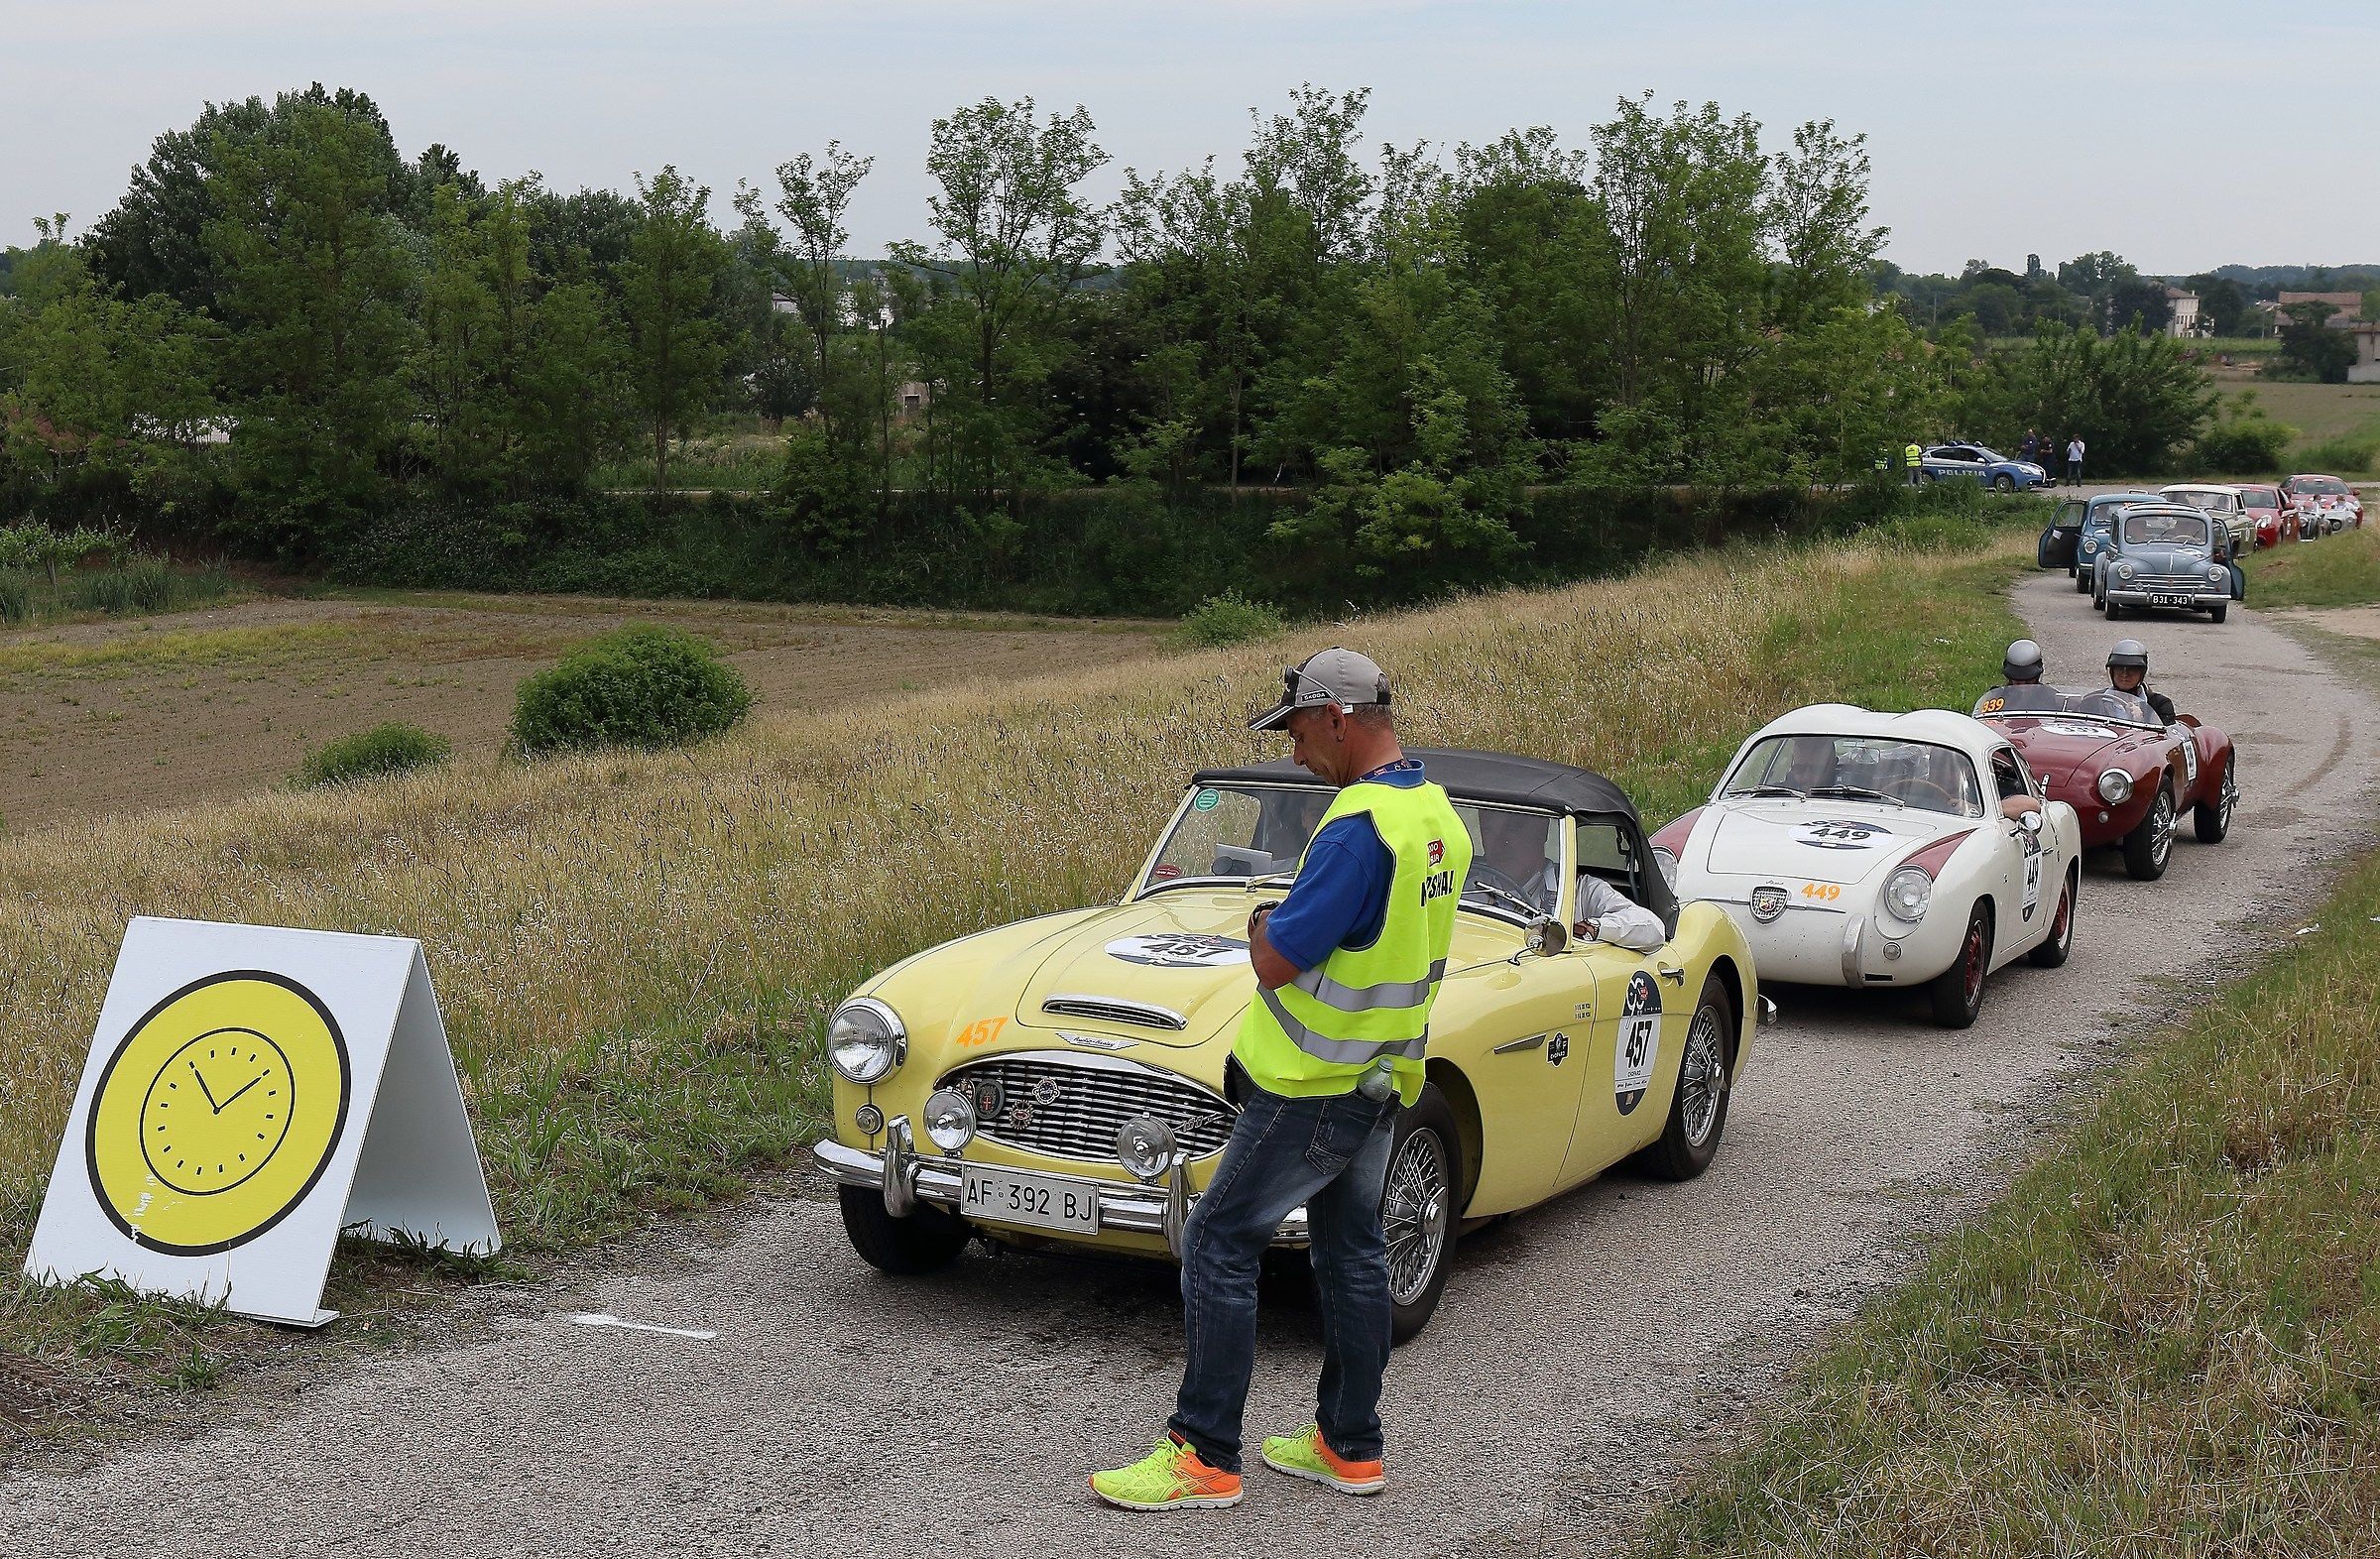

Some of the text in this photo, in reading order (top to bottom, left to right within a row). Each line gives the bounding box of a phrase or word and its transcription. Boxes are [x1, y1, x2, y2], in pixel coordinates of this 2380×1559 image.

[1981, 697, 2005, 713] 339
[1809, 827, 1872, 841] 449
[1800, 882, 1842, 902] 449
[1139, 942, 1235, 959] 457
[956, 1016, 1010, 1048] 457
[1624, 1019, 1653, 1068] 457
[967, 1177, 1092, 1221] AF 392 BJ
